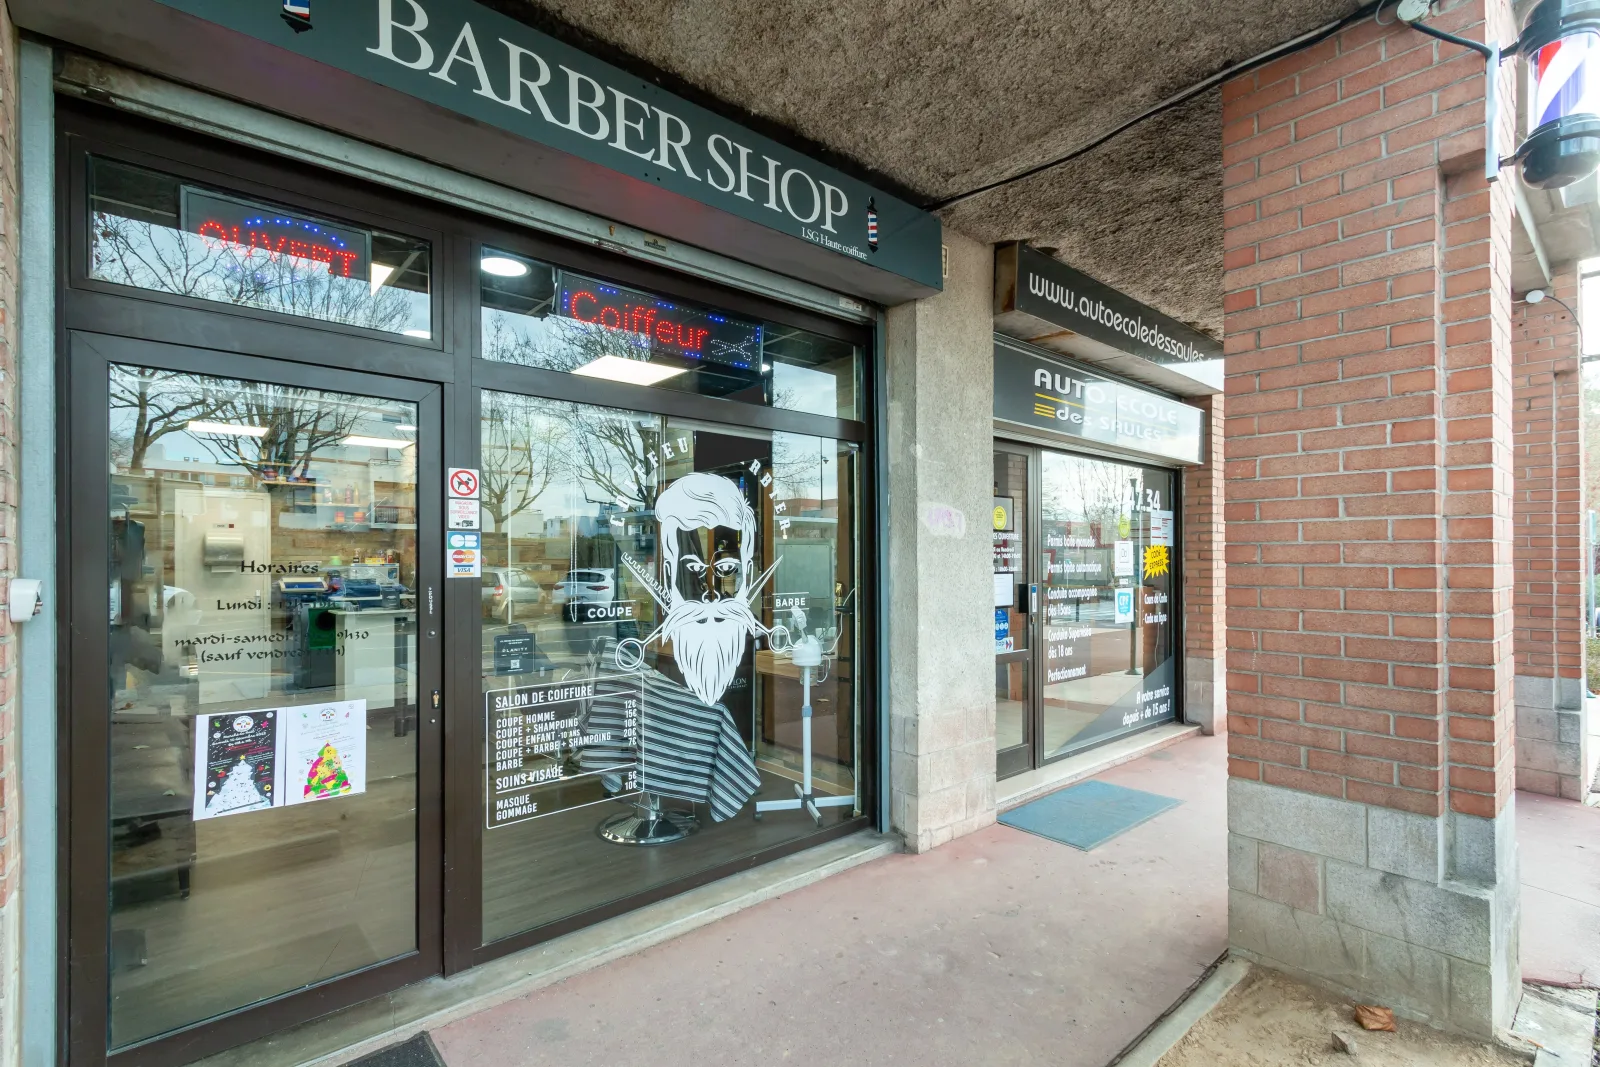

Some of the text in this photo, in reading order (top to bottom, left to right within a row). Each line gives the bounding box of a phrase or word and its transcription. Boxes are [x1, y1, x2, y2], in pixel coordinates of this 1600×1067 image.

[366, 0, 848, 234] BARBER SHOP
[200, 221, 357, 277] OUVERT
[802, 226, 868, 260] LSG Haute coiffure
[571, 291, 710, 349] Coiffeur
[1056, 406, 1162, 441] des SAULES
[610, 436, 697, 527] COIFFEU
[1048, 533, 1063, 547] Permis
[1076, 536, 1095, 547] manuelle
[240, 560, 319, 574] Horaires
[1048, 560, 1063, 573] Permis
[1076, 560, 1102, 575] automatique
[1048, 587, 1067, 600] Conduite
[1068, 585, 1097, 600] accompagnée
[1144, 593, 1153, 605] Cours
[1159, 592, 1168, 603] Code
[217, 600, 262, 611] Lundi
[776, 597, 806, 607] BARBE
[588, 606, 632, 618] COUPE
[1158, 612, 1167, 625] ligne
[174, 633, 290, 647] mardi-samedi
[1048, 624, 1092, 642] Conduite Supervisée
[201, 650, 243, 664] (sauf
[1064, 646, 1073, 656] ans
[1048, 664, 1086, 682] Perfectionnement
[496, 686, 592, 708] SALON DE COIFFURE
[1136, 685, 1170, 704] A votre service
[624, 700, 637, 709] 12€
[496, 711, 555, 729] COUPE HOMME
[625, 709, 637, 718] 15€
[1122, 711, 1139, 727] depuis
[1145, 707, 1151, 718] de
[1152, 704, 1159, 715] 15
[1159, 703, 1167, 713] ans
[496, 728, 522, 739] COUPE
[534, 718, 578, 734] SHAMPOING
[624, 719, 637, 728] 10€
[496, 738, 522, 750] COUPE
[526, 732, 555, 745] ENFANT
[569, 729, 580, 737] ANS
[623, 728, 637, 737] 20€
[496, 748, 523, 760] COUPE
[534, 740, 558, 754] BARBE
[569, 732, 611, 747] SHAMPOING
[628, 737, 637, 747] 7€
[496, 758, 523, 771] BARBE
[496, 765, 564, 790] SOINS VISAGE
[628, 771, 637, 780] 5€
[625, 780, 637, 790] 10€
[496, 794, 530, 810] MASQUE
[496, 803, 537, 821] GOMMAGE
